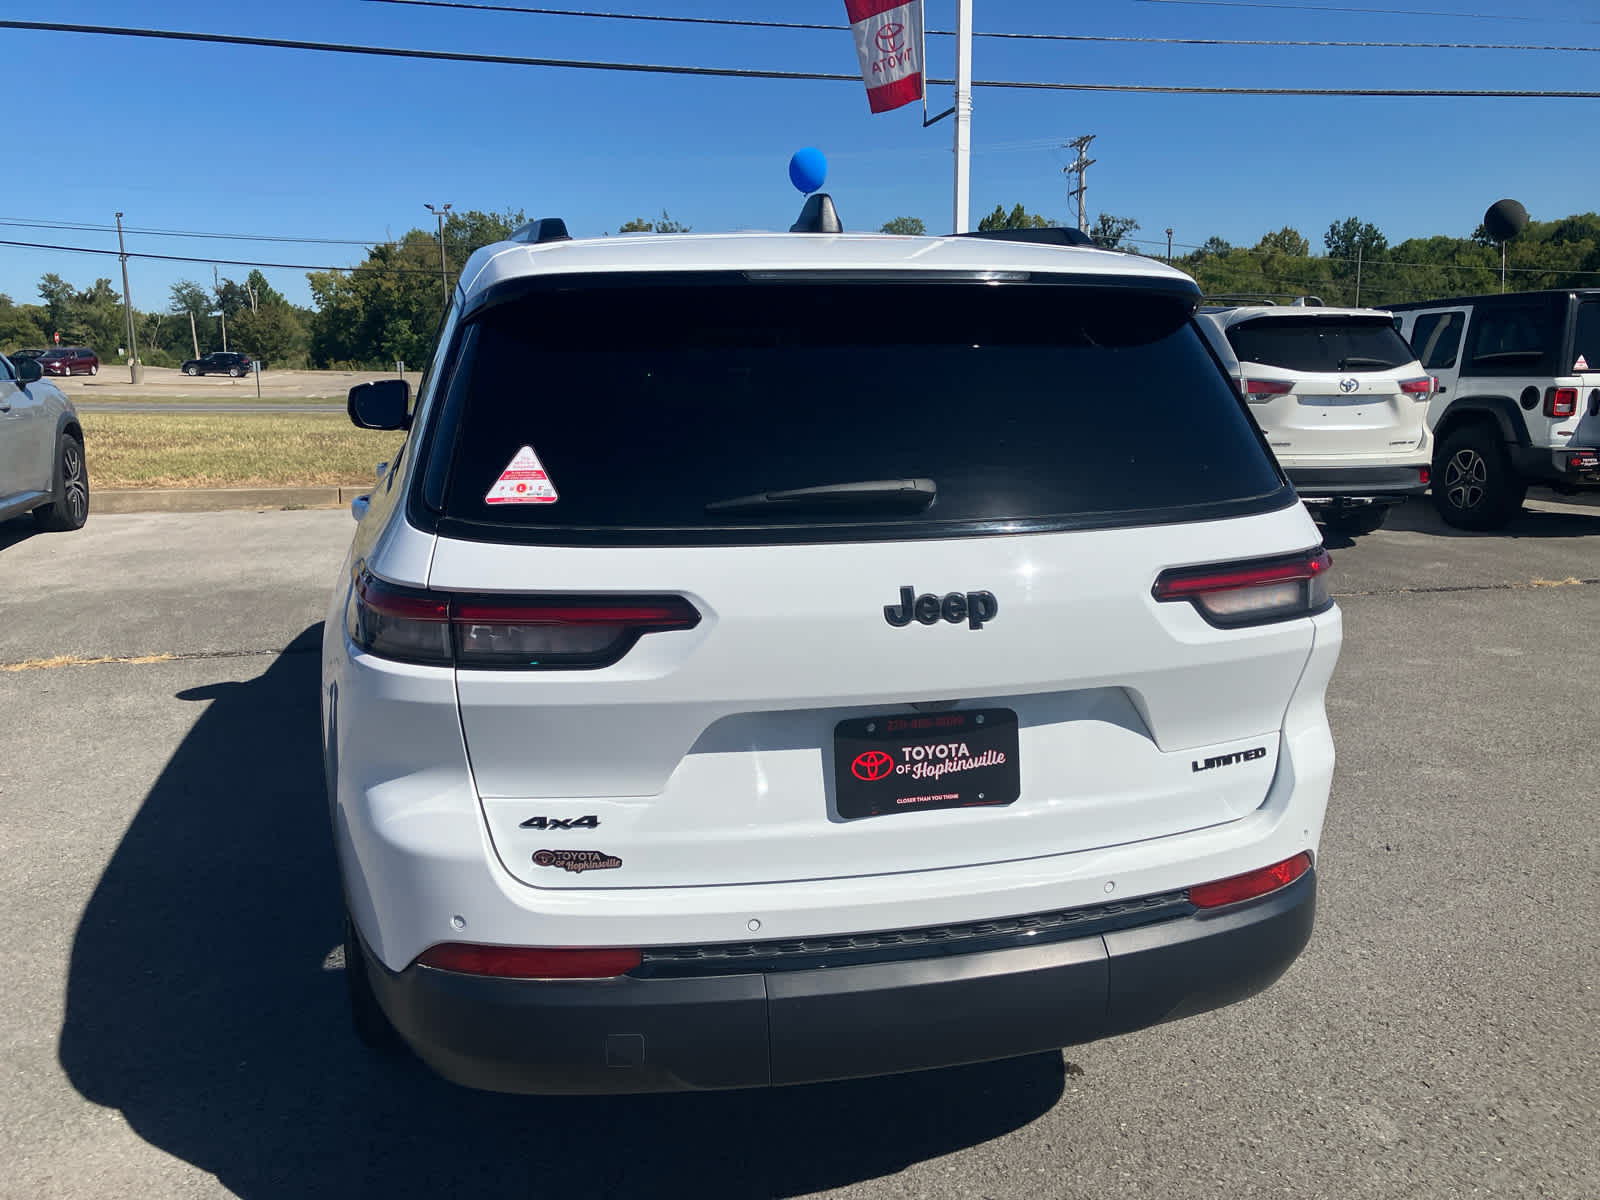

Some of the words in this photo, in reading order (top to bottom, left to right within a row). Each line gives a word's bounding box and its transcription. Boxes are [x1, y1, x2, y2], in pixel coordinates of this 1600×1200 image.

[884, 585, 998, 630] Jeep
[902, 742, 970, 762] TOYOTA
[1191, 746, 1267, 773] LIMITED
[895, 763, 911, 775] OF
[911, 749, 1006, 780] Hopkinsville
[896, 796, 916, 804] CLOSER
[519, 815, 599, 830] 4x4
[555, 852, 601, 861] TOYOTA
[566, 858, 621, 872] Hopkinsville
